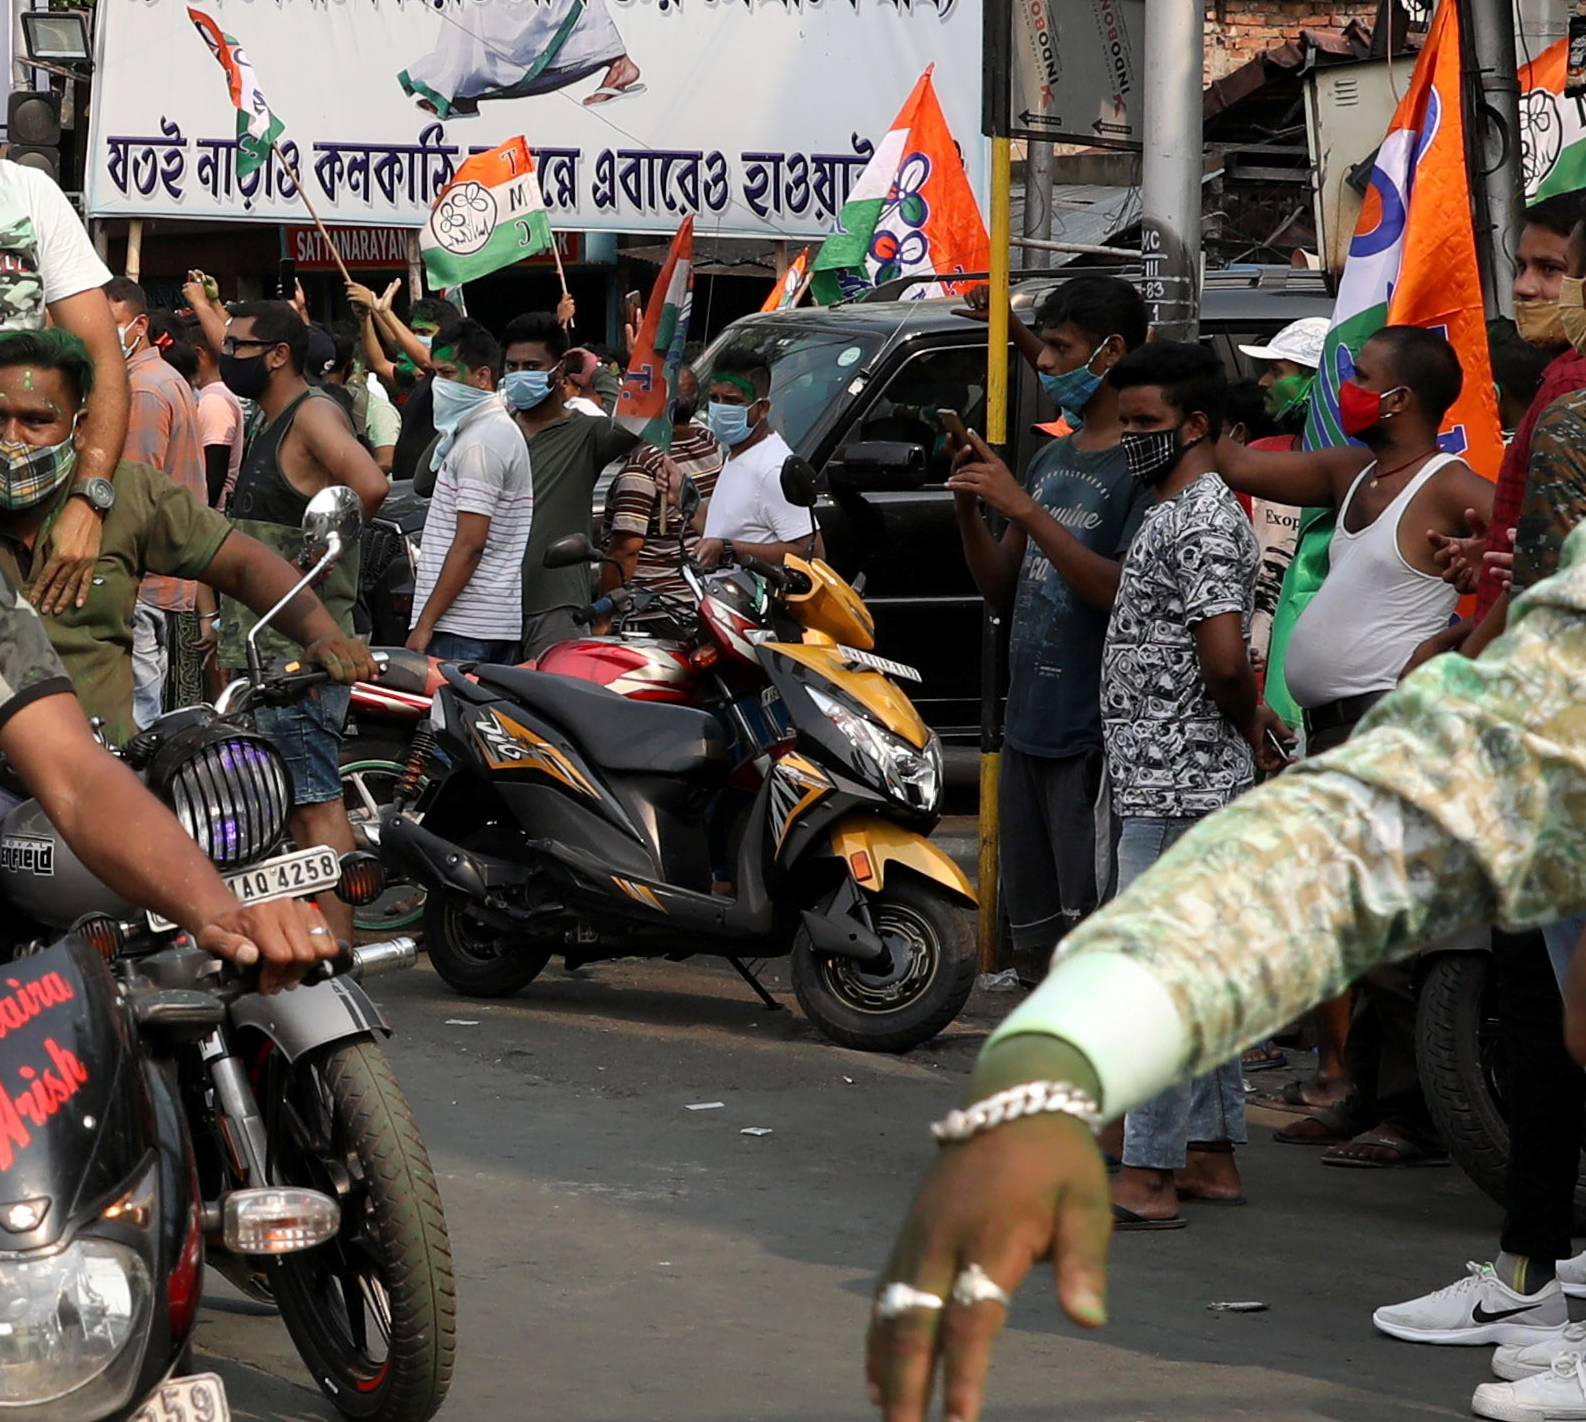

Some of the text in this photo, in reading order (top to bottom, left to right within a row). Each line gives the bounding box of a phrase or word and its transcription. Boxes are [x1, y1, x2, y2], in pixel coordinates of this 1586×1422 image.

[108, 116, 188, 206] যতই
[595, 149, 731, 218] এবারেও
[277, 854, 337, 889] 4258
